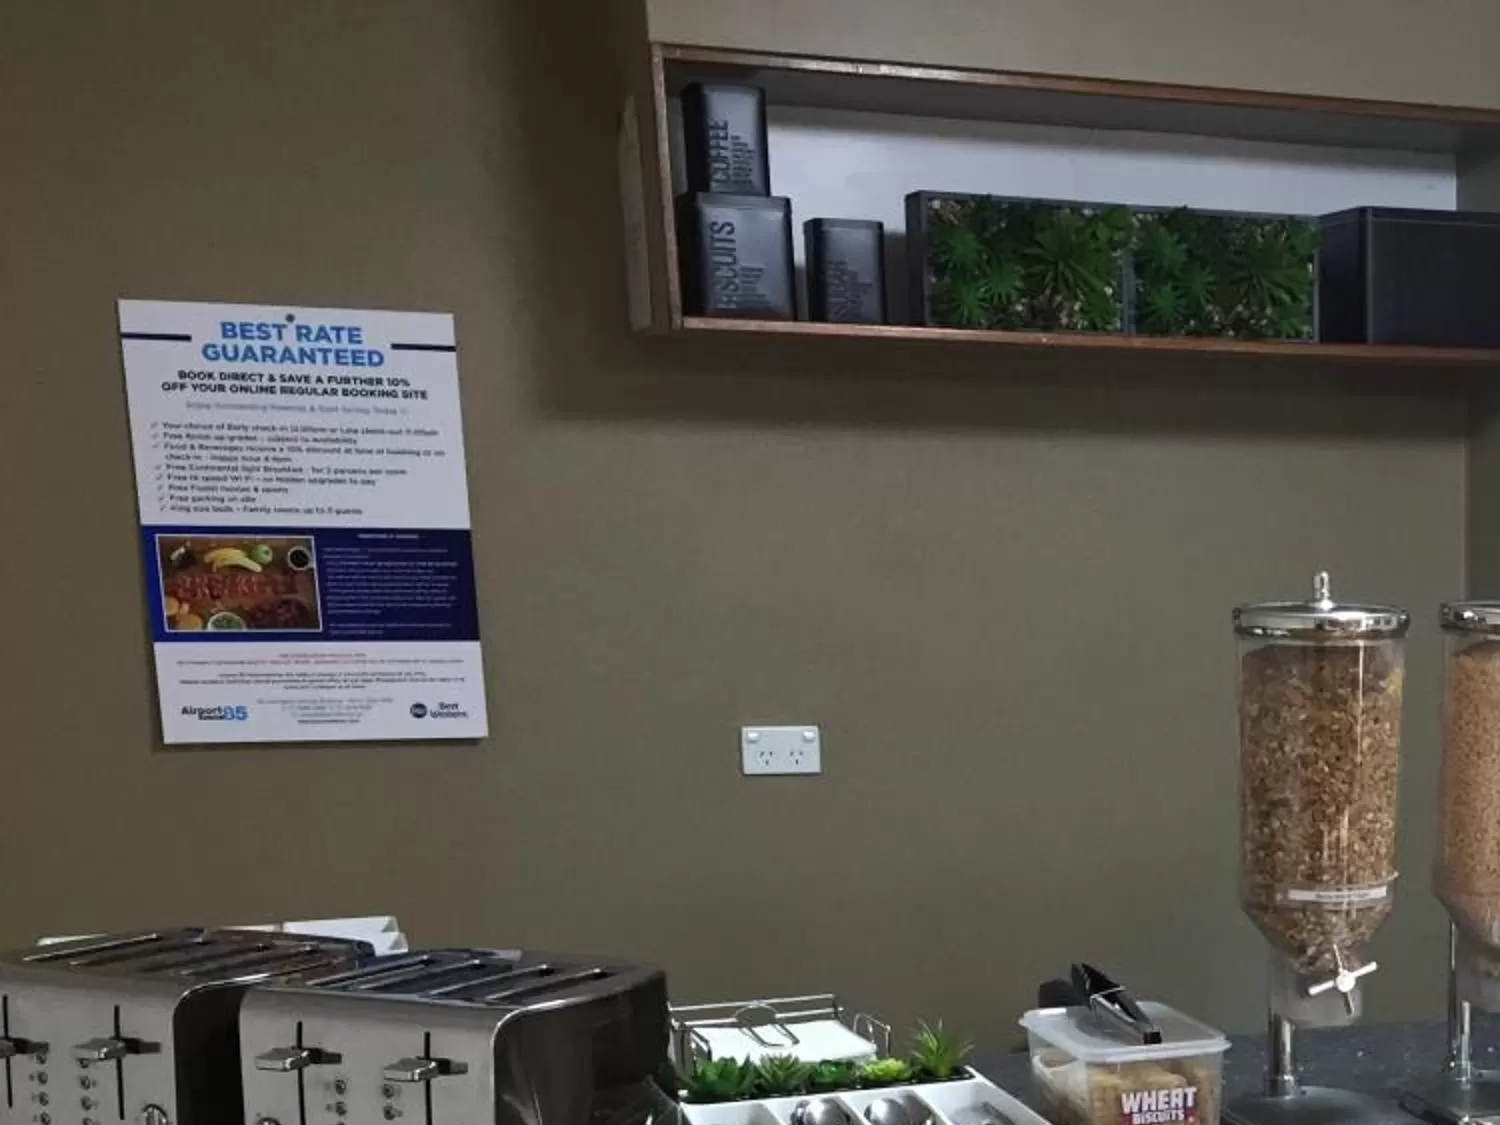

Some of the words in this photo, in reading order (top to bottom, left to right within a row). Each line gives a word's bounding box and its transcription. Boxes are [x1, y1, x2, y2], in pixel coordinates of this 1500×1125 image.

[220, 321, 287, 341] BEST
[295, 324, 363, 344] RATE
[202, 343, 385, 367] GUARANTEED
[177, 370, 216, 381] BOOK
[219, 371, 264, 383] DIRECT
[268, 373, 277, 383] &
[279, 373, 312, 384] SAVE
[315, 375, 325, 384] A
[327, 375, 384, 387] FURTHER
[387, 377, 411, 388] 10%
[161, 382, 188, 392] OFF
[191, 383, 226, 393] YOUR
[229, 384, 277, 395] ONLINE
[280, 385, 339, 397] REGULAR
[342, 387, 399, 399] BOOKING
[402, 389, 429, 400] SITE
[1121, 1086, 1197, 1115] WHEAT
[1132, 1109, 1185, 1125] BISCUITS
